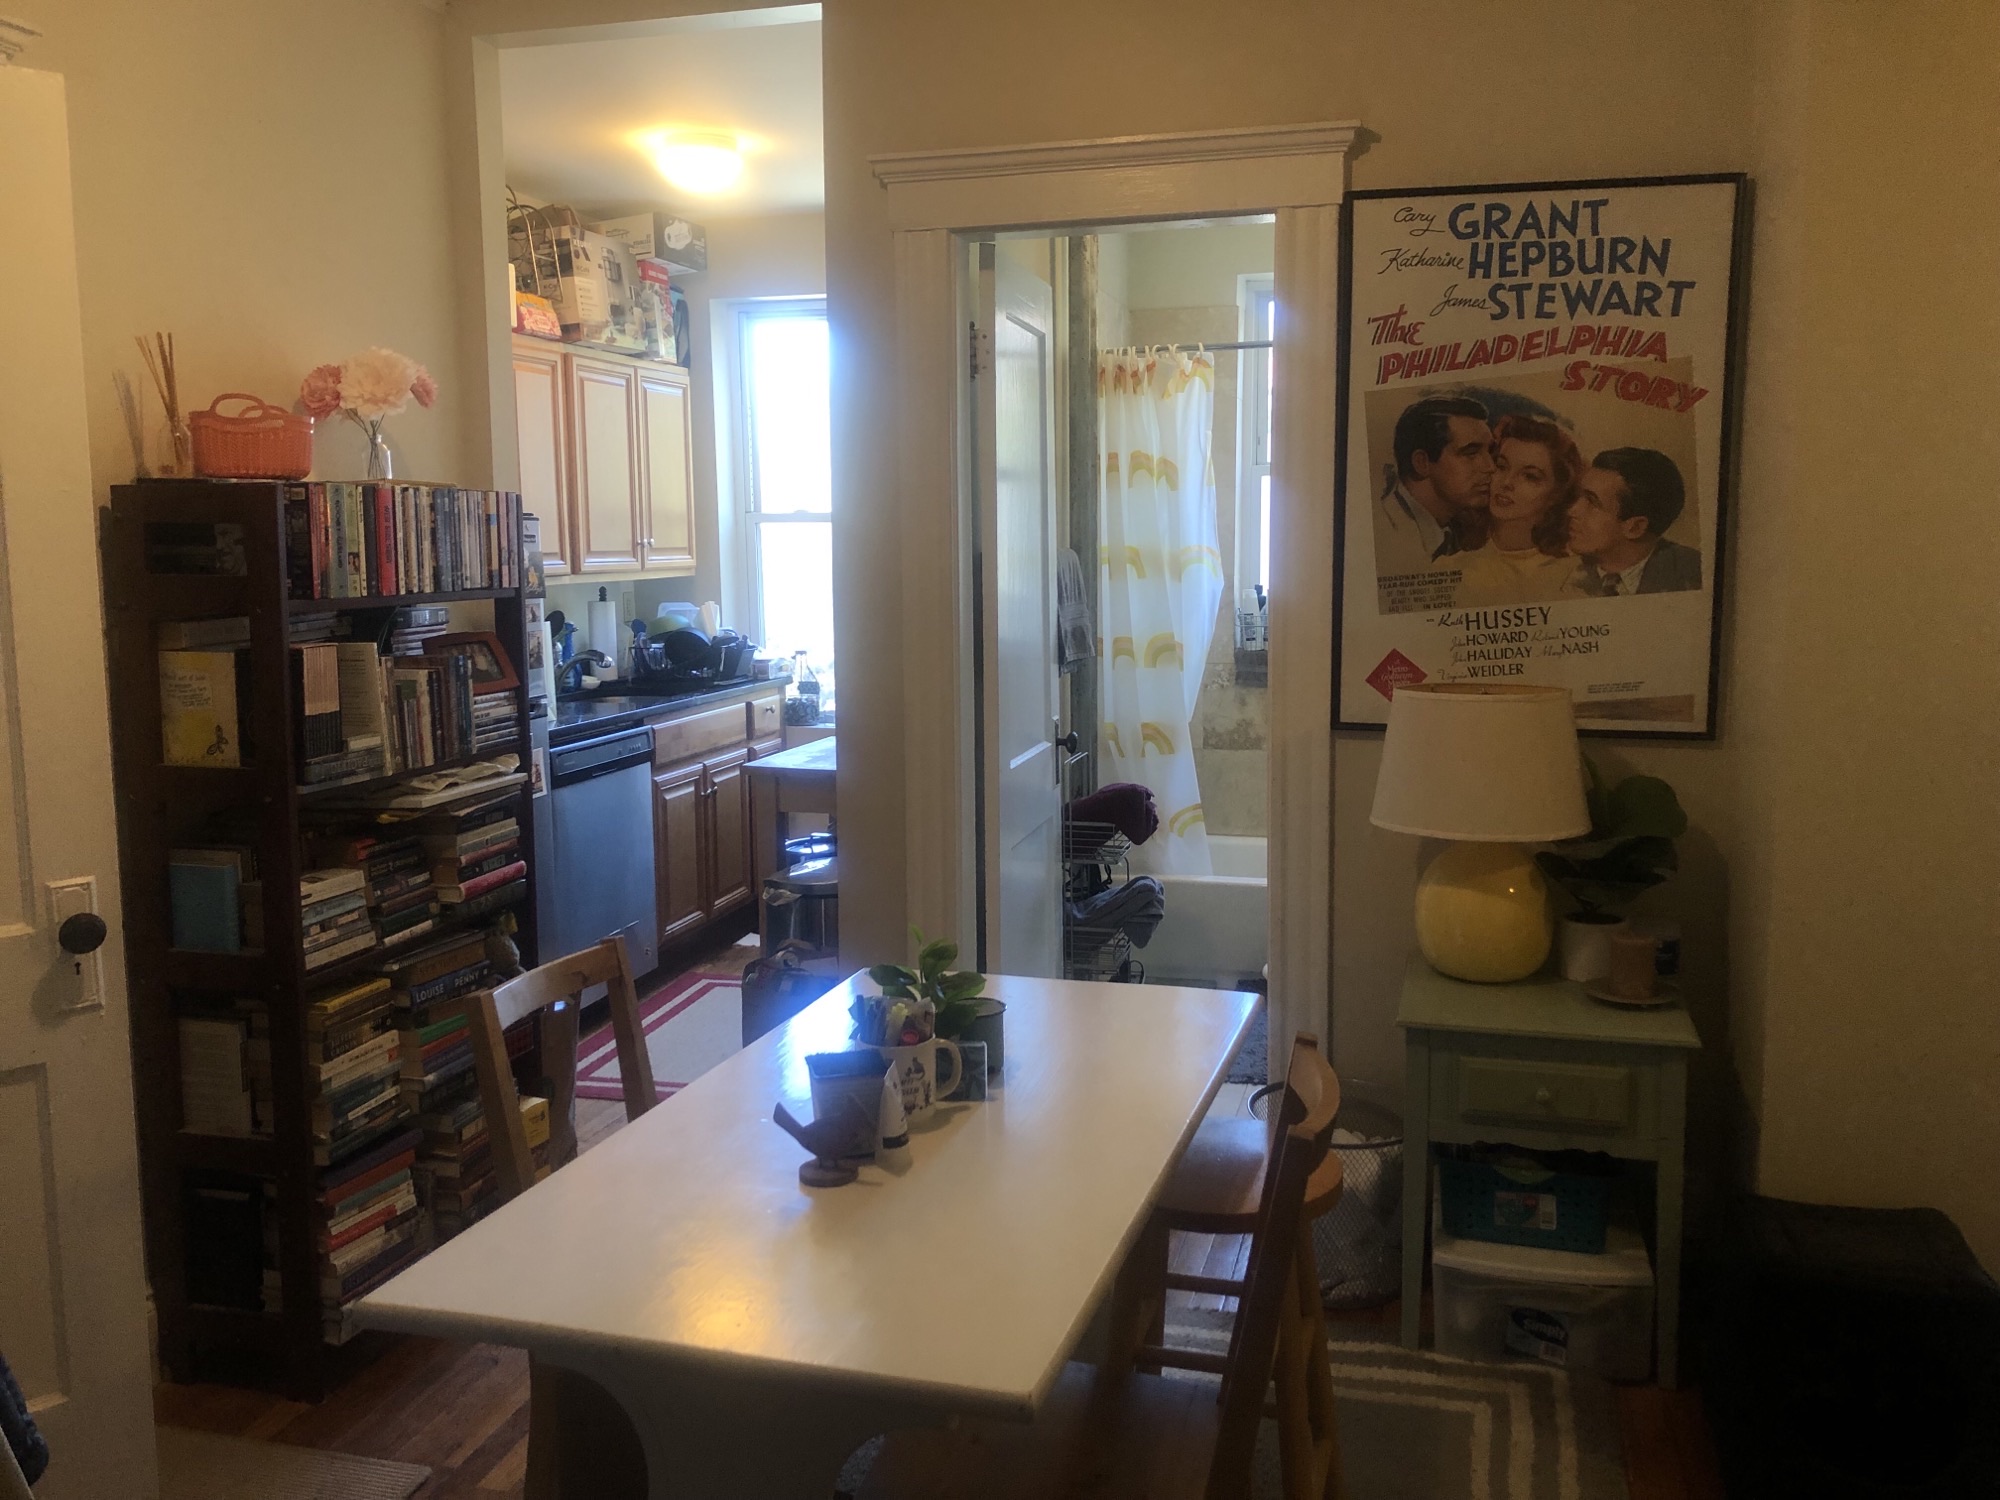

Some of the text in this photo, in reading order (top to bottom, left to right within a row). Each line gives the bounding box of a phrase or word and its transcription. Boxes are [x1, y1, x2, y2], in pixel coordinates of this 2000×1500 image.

[1394, 199, 1609, 240] Cary GRANT
[1378, 236, 1671, 279] Katharine HEPBURN
[1430, 280, 1696, 321] James STEWART
[1376, 325, 1668, 385] PHILADELPHIA
[1560, 361, 1709, 413] STORY
[1378, 570, 1463, 582] BROADWAY'S HOWLING
[1378, 581, 1415, 589] YEAR-RUN
[1417, 579, 1448, 587] COMEDY
[1438, 612, 1464, 628] Ruth
[1464, 606, 1551, 631] HUSSEY
[1466, 631, 1528, 646] HOWARD
[1559, 624, 1610, 641] YOUNG
[1467, 647, 1532, 662] HALLIDAY
[1562, 641, 1600, 655] NASH
[1467, 663, 1525, 679] WEIDLER
[415, 972, 480, 1002] LOUISE PENNY
[1522, 1316, 1567, 1341] Simply
